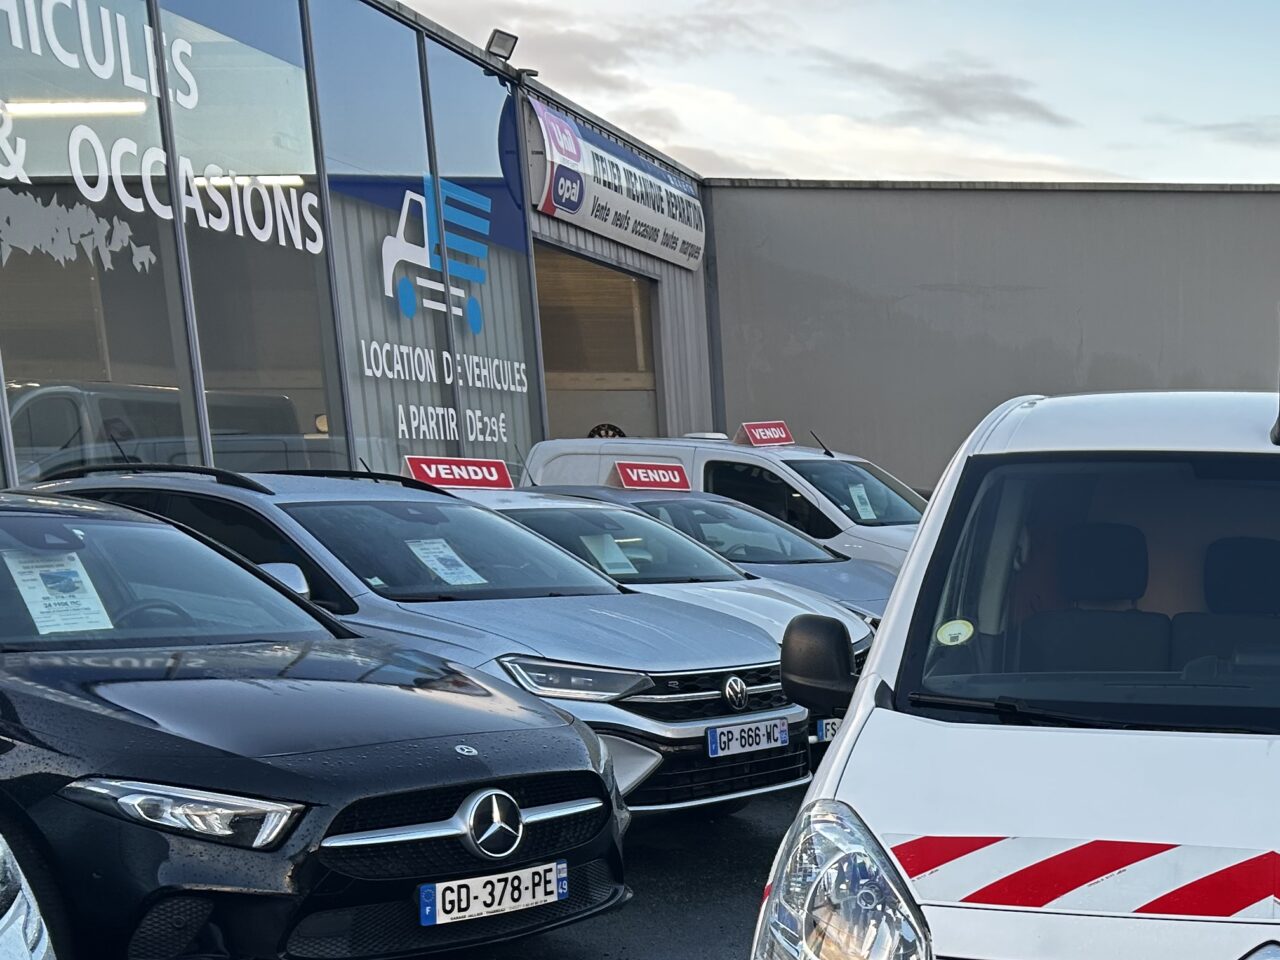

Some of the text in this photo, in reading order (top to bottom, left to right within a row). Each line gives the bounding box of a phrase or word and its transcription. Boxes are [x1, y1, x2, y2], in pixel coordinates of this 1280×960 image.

[68, 124, 324, 255] OCCASIONS
[557, 176, 580, 203] opal
[591, 151, 624, 196] ATELIER
[623, 167, 665, 215] MECANIQUE
[590, 195, 611, 223] Vente
[611, 209, 630, 231] neufs
[361, 339, 437, 383] LOCATION
[463, 353, 528, 393] VEHICULES
[398, 404, 409, 439] A
[409, 405, 459, 441] PARTIR
[466, 409, 484, 442] DE
[751, 427, 787, 440] VENDU
[420, 463, 499, 481] VENDU
[626, 468, 681, 483] VENDU
[719, 724, 779, 751] GP-666-WC
[425, 906, 431, 915] F
[441, 868, 555, 915] GD-378-PE
